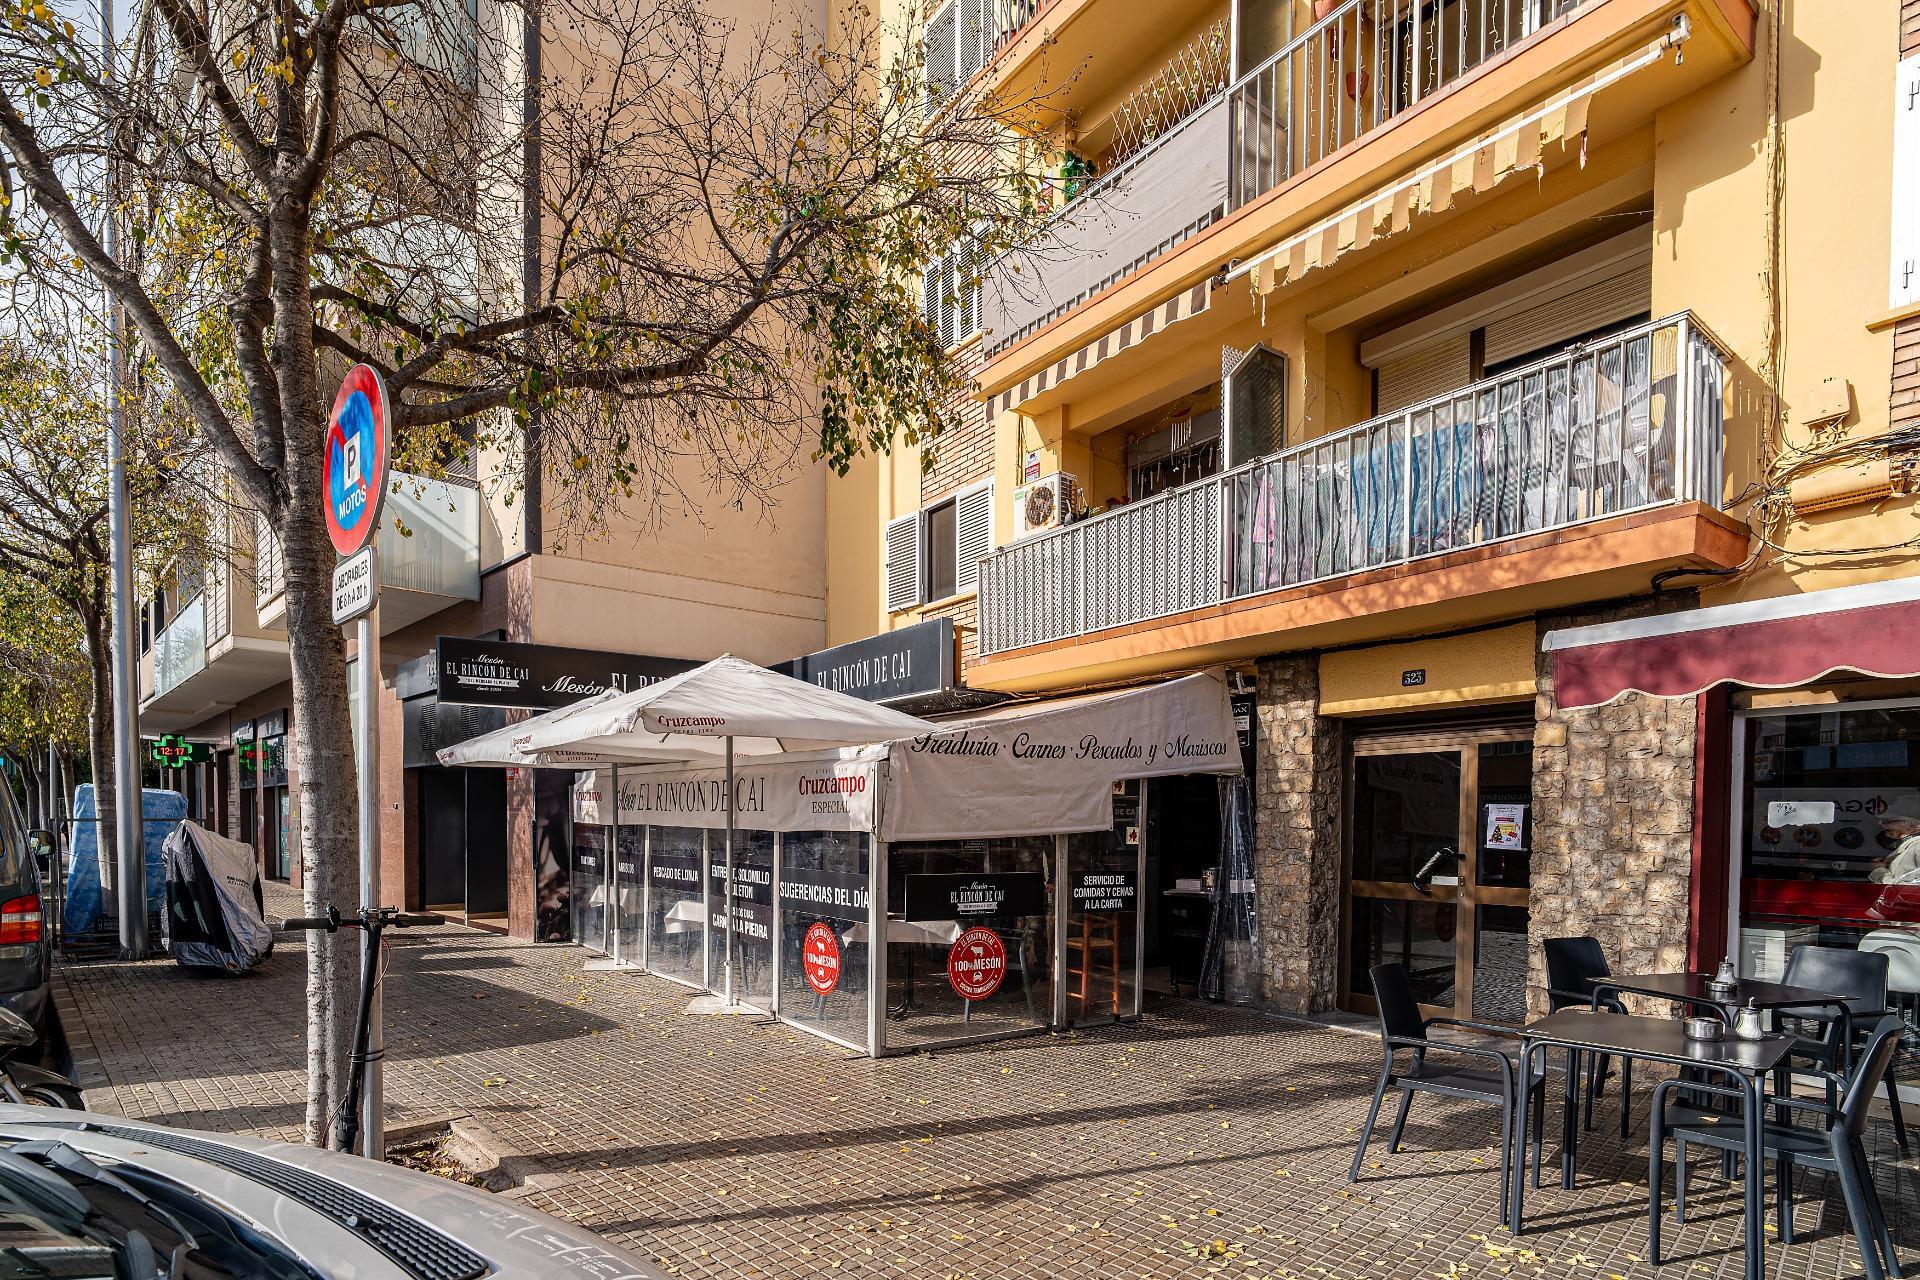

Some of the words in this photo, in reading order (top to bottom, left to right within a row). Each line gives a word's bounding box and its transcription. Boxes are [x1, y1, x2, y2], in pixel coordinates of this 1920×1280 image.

[347, 443, 357, 480] P
[338, 484, 368, 521] MOTOS
[335, 559, 369, 592] LABORABLES
[336, 593, 343, 612] DE
[471, 653, 506, 665] Mesón
[446, 661, 458, 675] EL
[462, 663, 496, 678] RINCÓN
[499, 666, 511, 679] DE
[514, 667, 529, 681] CAI
[817, 670, 829, 689] EL
[832, 659, 870, 692] RINCÓN
[874, 655, 888, 684] DE
[892, 650, 912, 680] CAI
[1404, 671, 1422, 684] 323
[541, 675, 606, 695] Mesón
[657, 715, 726, 728] Cruzcampo
[911, 731, 999, 756] Freiduría
[1012, 732, 1066, 759] Carnes
[1075, 734, 1142, 760] Pescados
[1144, 743, 1158, 766] y
[1164, 734, 1227, 759] Mariscos
[637, 783, 652, 811] EL
[711, 780, 728, 812] DE
[736, 777, 766, 812] CAI
[798, 774, 866, 797] Cruzcampo
[812, 799, 851, 814] ESPECIAL
[653, 866, 674, 881] PESCADO
[674, 868, 681, 881] DE
[681, 869, 699, 883] LONJA
[737, 867, 770, 885] SOLOMILLO
[1083, 875, 1115, 886] SERVICIO
[1115, 875, 1125, 885] DE
[779, 881, 833, 904] SUGERENCIAS
[836, 887, 852, 907] DEL
[853, 886, 870, 909] DÍA
[950, 891, 959, 903] EL
[960, 889, 983, 903] RINCÓN
[984, 890, 993, 902] DE
[994, 890, 1005, 902] CAI
[1073, 887, 1106, 898] COMIDAS
[1106, 887, 1111, 897] Y
[1112, 886, 1134, 897] CENAS
[1084, 899, 1090, 910] A
[1090, 899, 1100, 909] LA
[1100, 898, 1123, 909] CARTA
[744, 920, 769, 940] PIEDRA
